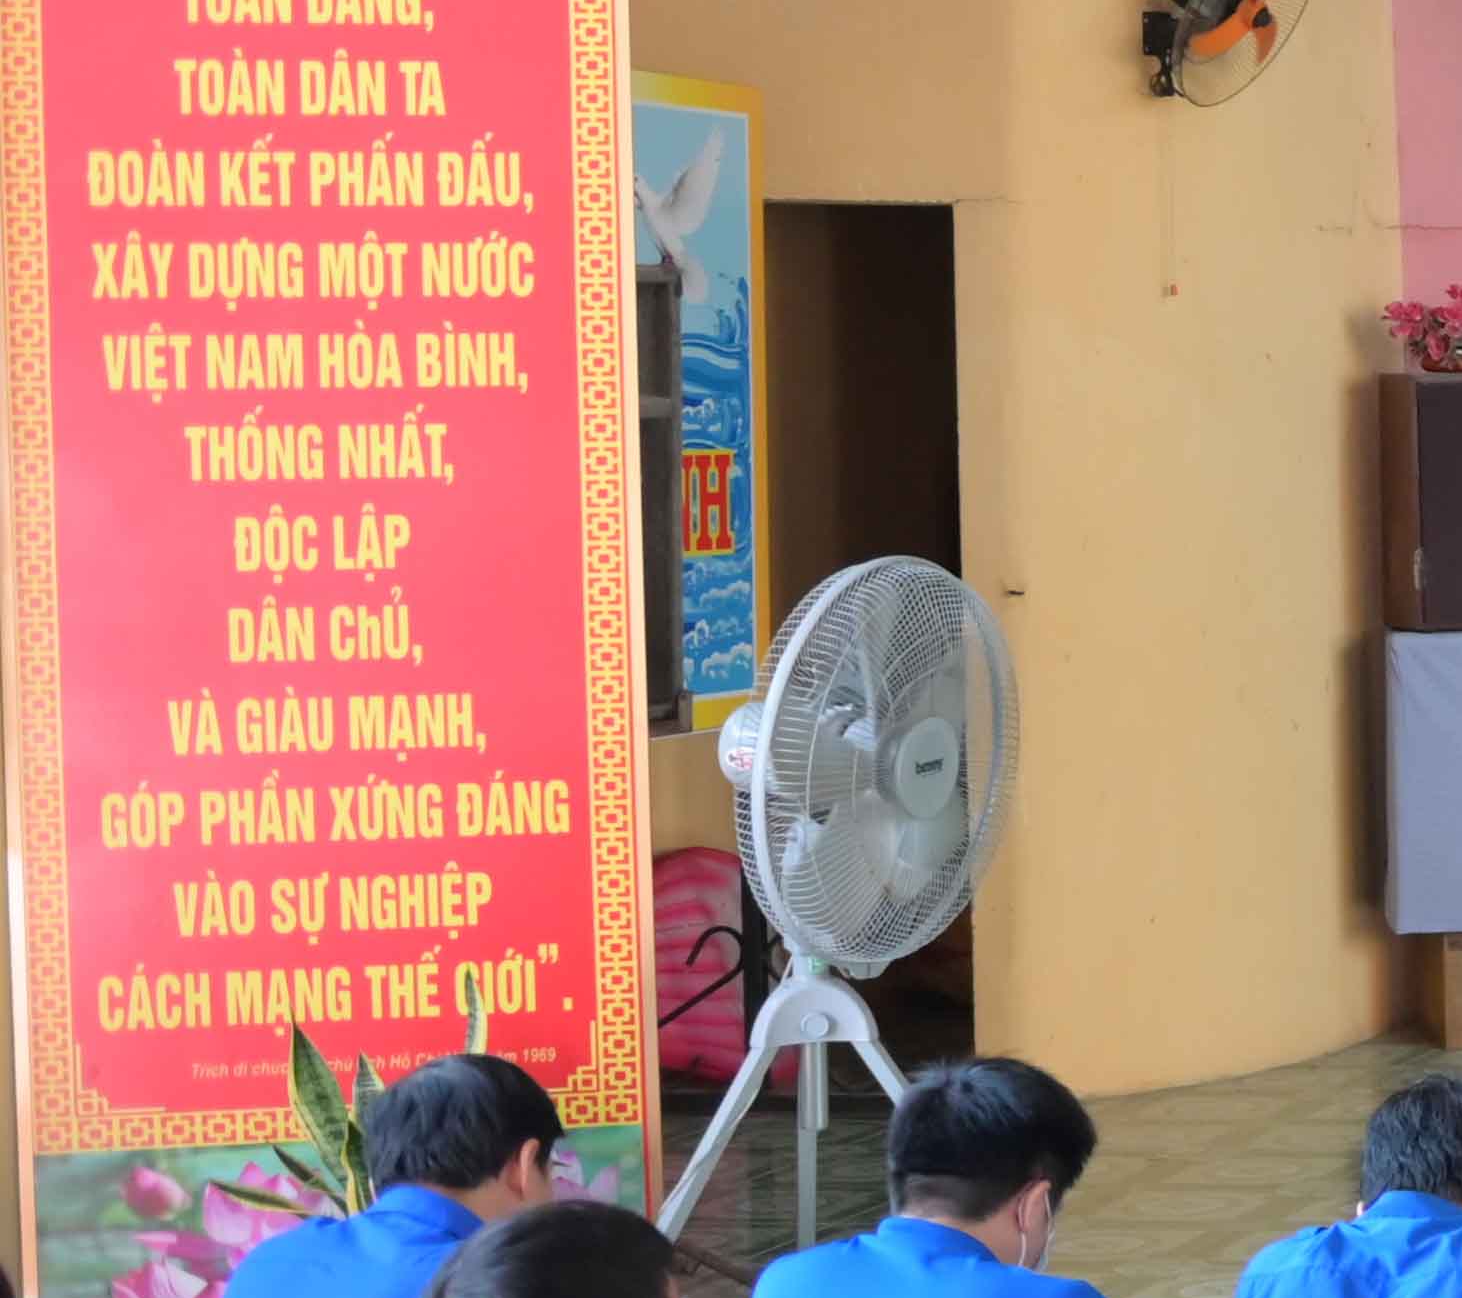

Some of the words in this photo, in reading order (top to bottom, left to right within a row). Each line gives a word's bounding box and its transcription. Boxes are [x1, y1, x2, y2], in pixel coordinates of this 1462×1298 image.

[88, 139, 205, 207] ĐOÀN
[220, 134, 295, 207] KẾT
[310, 132, 424, 206] PHẤN
[437, 132, 533, 213] ĐẤU,
[103, 323, 191, 403] VIỆT
[207, 334, 303, 389] NAM
[319, 320, 403, 388] HÒA
[416, 321, 527, 393] BÌNH,
